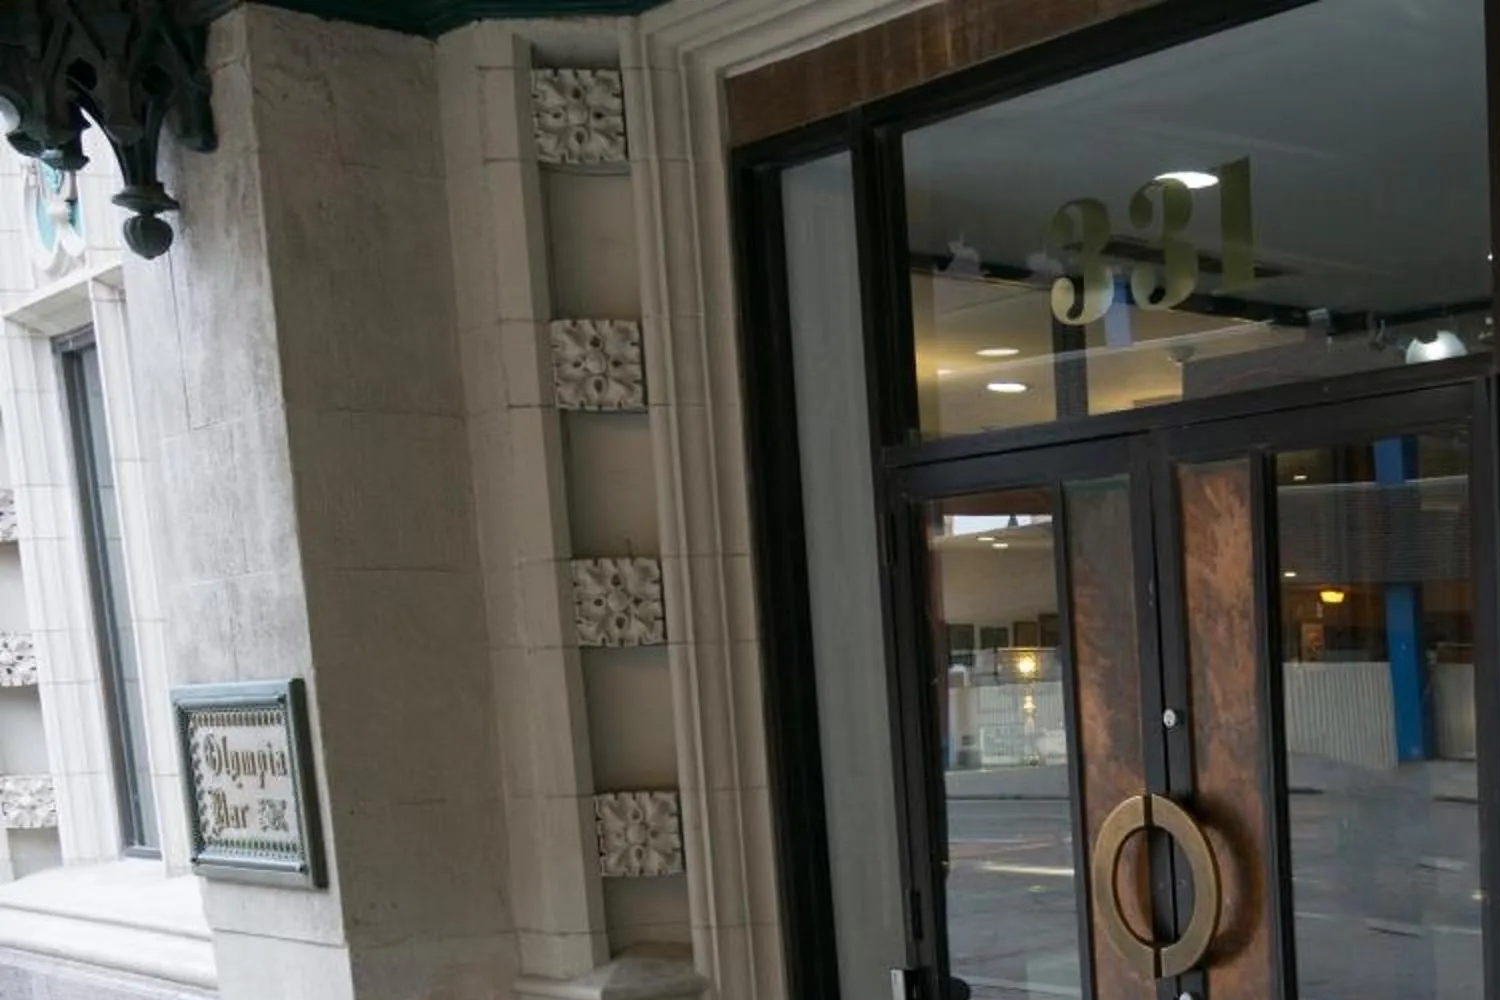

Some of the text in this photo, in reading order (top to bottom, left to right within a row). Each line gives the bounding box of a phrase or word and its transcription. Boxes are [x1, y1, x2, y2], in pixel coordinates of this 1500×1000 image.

[1050, 155, 1254, 325] 331
[203, 733, 288, 789] Olympia
[208, 789, 249, 836] Bar
